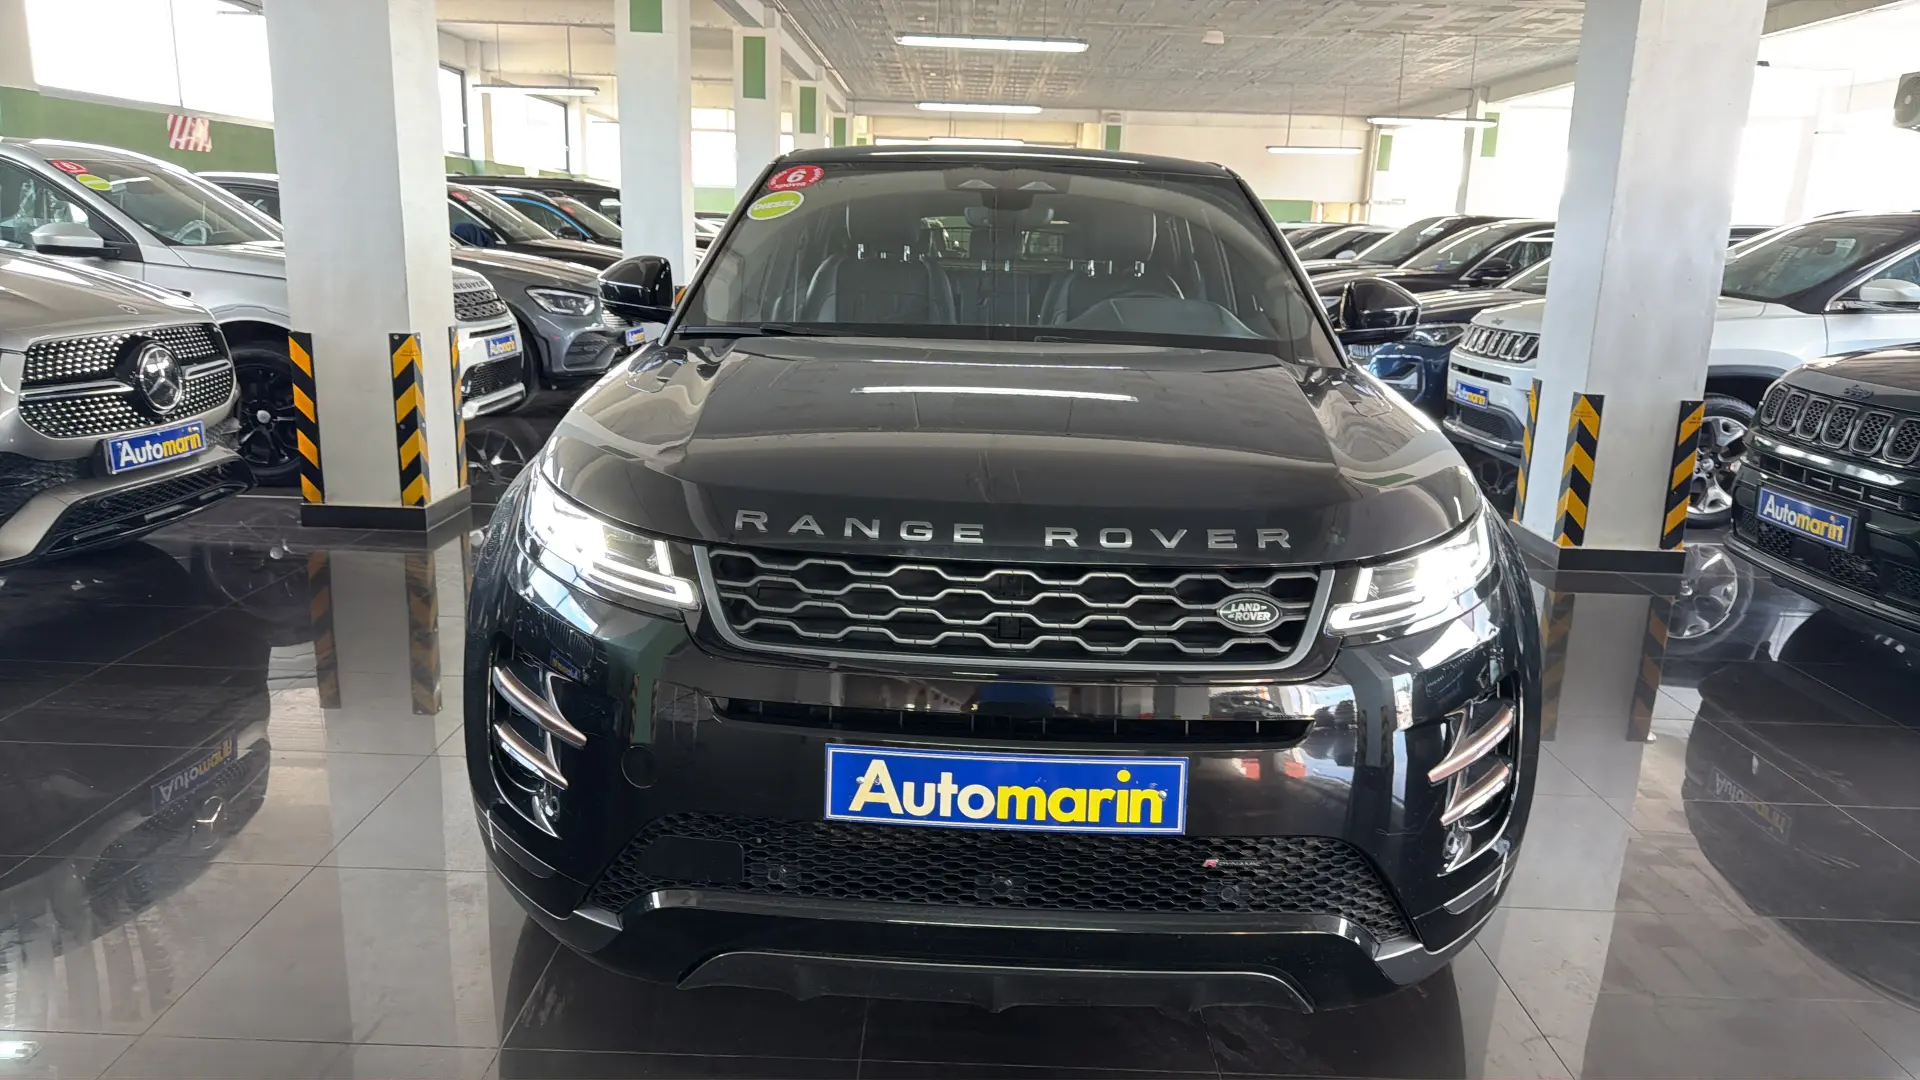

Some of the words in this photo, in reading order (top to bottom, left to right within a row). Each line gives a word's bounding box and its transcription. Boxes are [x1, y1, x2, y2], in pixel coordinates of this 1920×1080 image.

[787, 169, 806, 183] 6
[120, 427, 202, 467] Automarin
[734, 509, 984, 544] RANGE
[1044, 526, 1292, 549] ROVER
[1762, 494, 1845, 542] Automarin
[1231, 603, 1261, 612] LAND
[1234, 611, 1272, 621] ROVER
[848, 759, 1163, 824] Automarin
